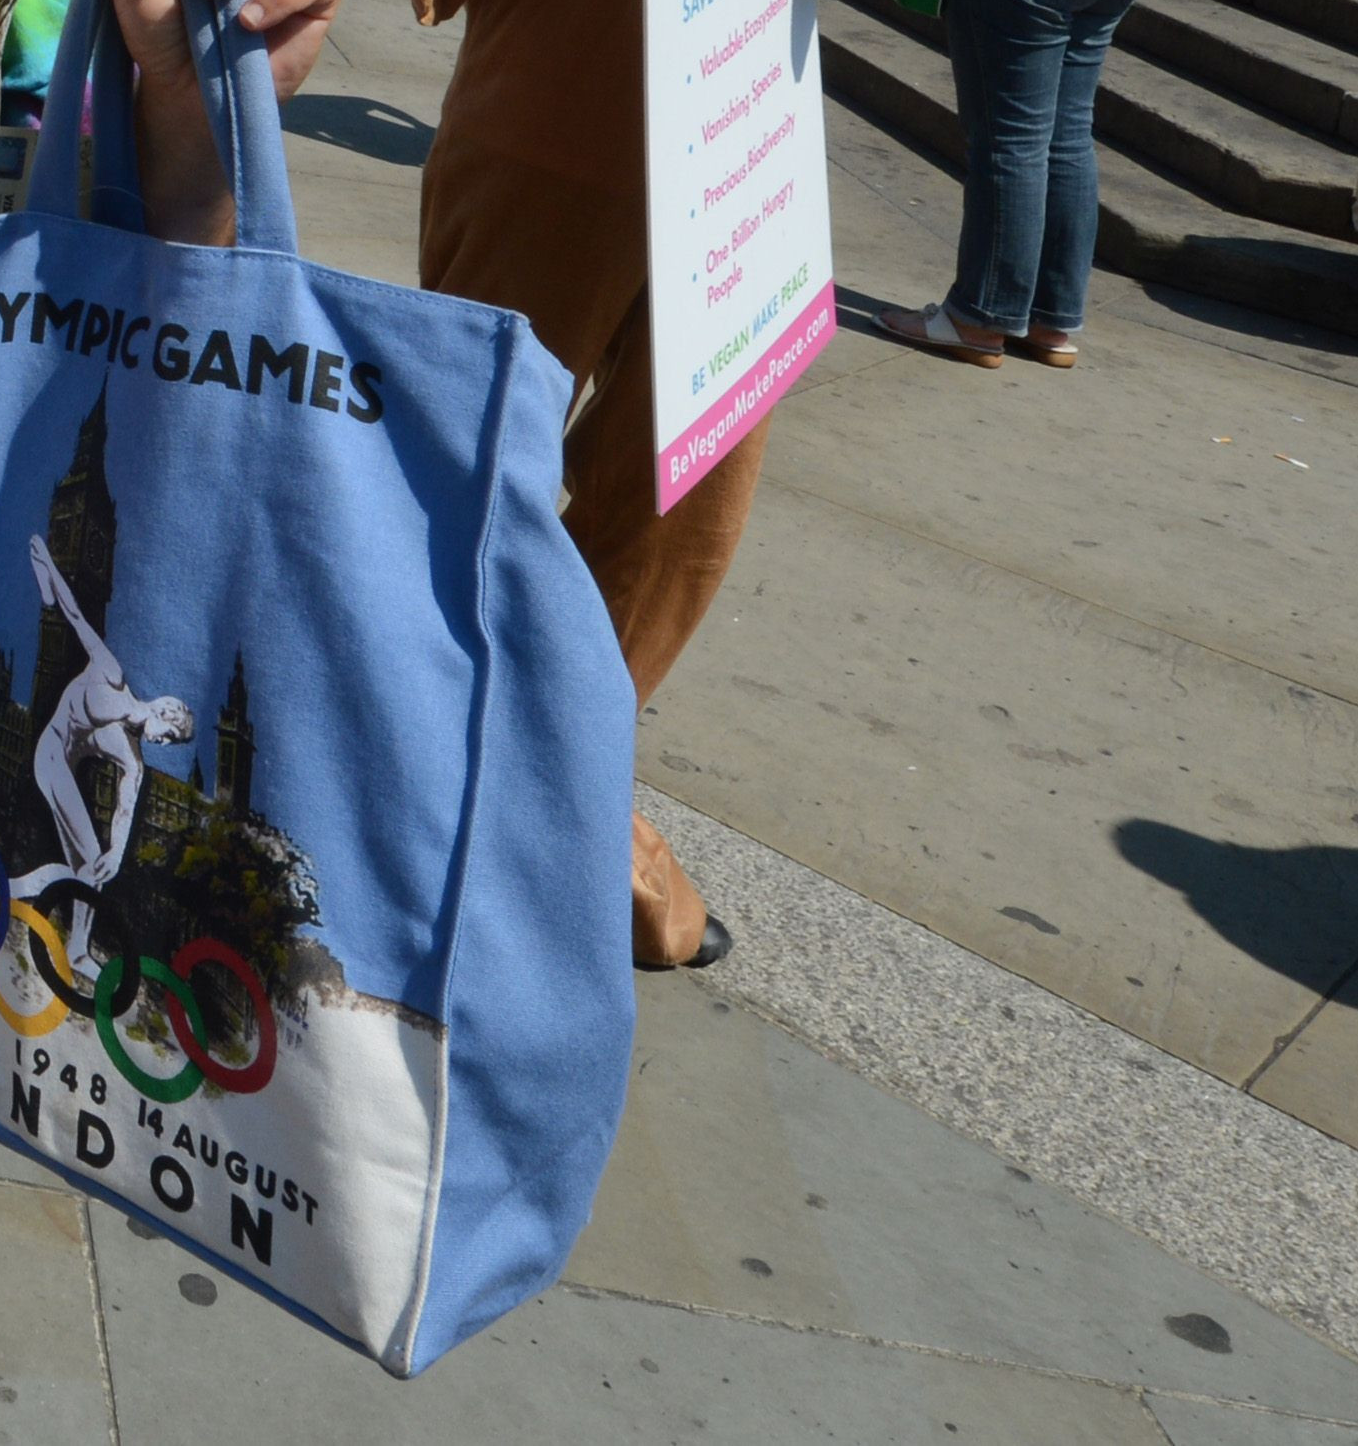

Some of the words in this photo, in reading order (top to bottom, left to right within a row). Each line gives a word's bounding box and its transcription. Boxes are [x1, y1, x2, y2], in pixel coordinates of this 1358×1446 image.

[699, 29, 743, 81] Valuable
[701, 94, 750, 145] Vanishing
[752, 62, 782, 103] Species
[703, 163, 747, 211] Precious
[747, 112, 796, 173] Biodiversity
[706, 244, 729, 274] One
[731, 214, 761, 253] Billion
[761, 178, 795, 224] Hungry
[692, 366, 706, 396] BE
[709, 325, 750, 378] VEGAN
[752, 295, 779, 339] MAKE
[781, 262, 809, 308] PEACE
[706, 263, 744, 308] People
[149, 327, 387, 426] GAMES
[669, 306, 830, 485] BeVeganMakePeace.com
[14, 1040, 110, 1103] 1948
[137, 1095, 166, 1141] 14
[171, 1124, 321, 1227] AUGUST
